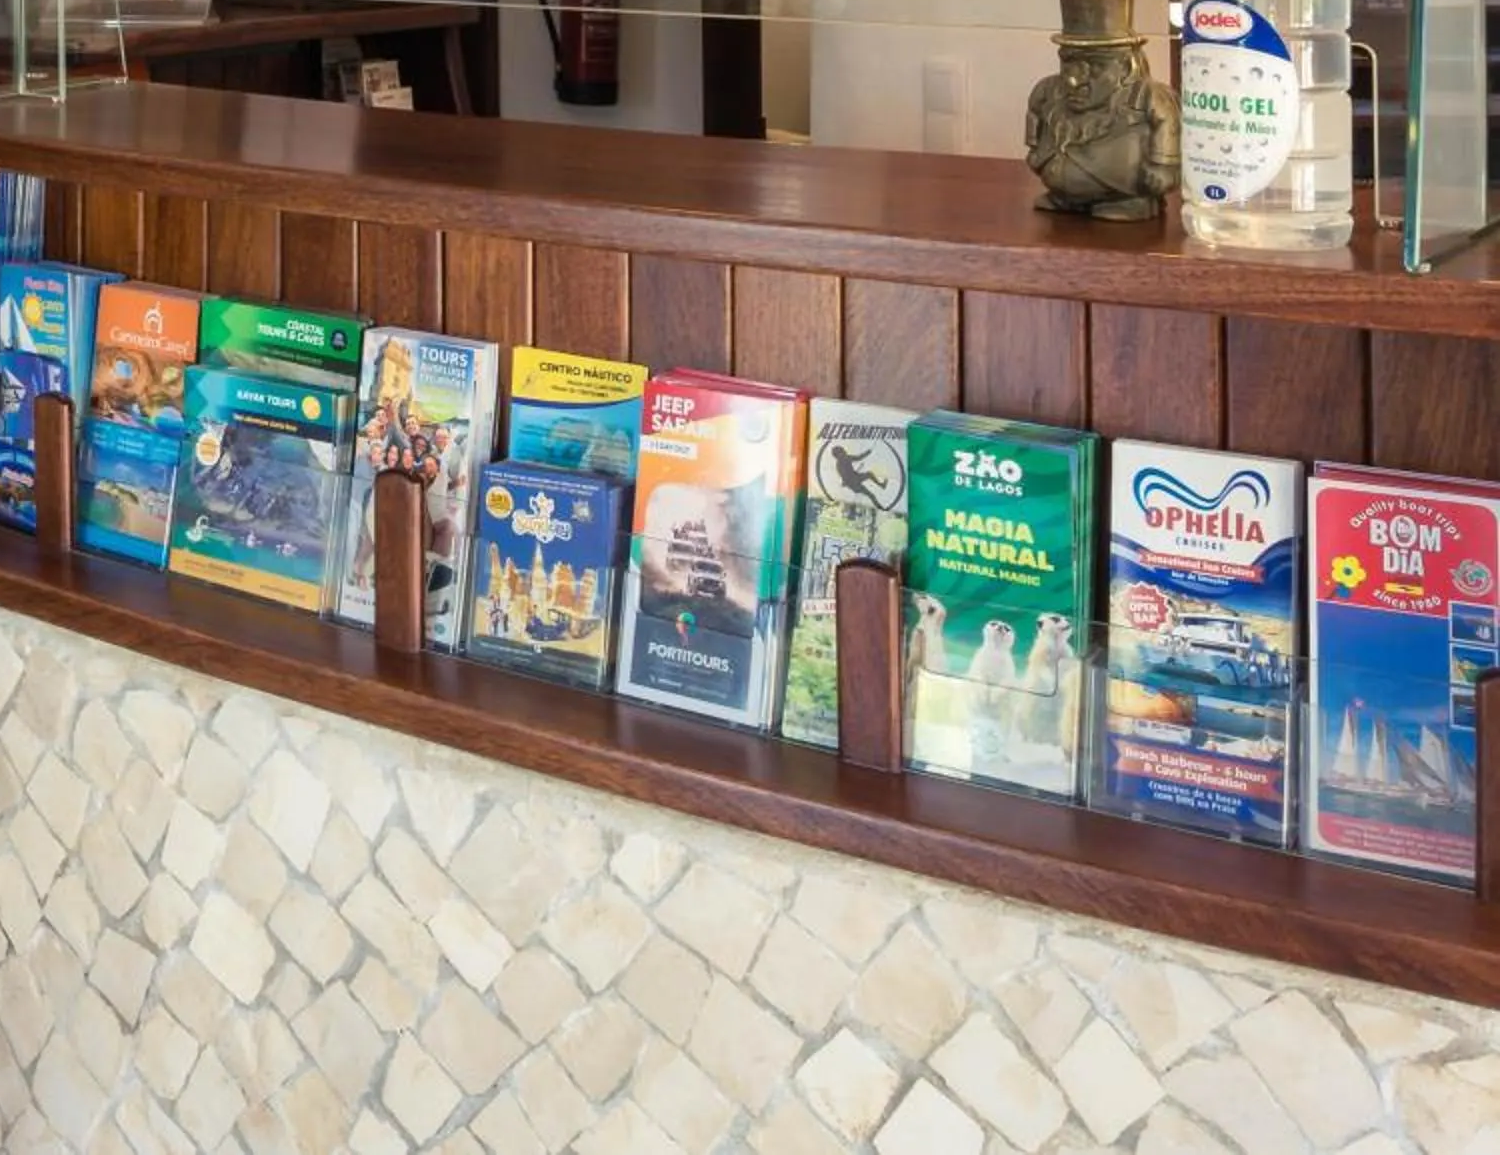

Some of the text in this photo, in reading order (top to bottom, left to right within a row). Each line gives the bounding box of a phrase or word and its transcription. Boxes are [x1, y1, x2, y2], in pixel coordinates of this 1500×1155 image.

[1240, 96, 1278, 116] GEL
[258, 323, 287, 340] TOURS
[297, 331, 325, 347] CAVES
[286, 319, 325, 337] COASTAL
[420, 346, 469, 368] TOURS
[539, 362, 633, 384] CENTRO NÁUTICO
[236, 389, 298, 411] KAYAK TOURS
[652, 394, 695, 416] JEEP
[955, 475, 1023, 497] DE LAGOS
[944, 508, 1035, 545] MAGIA
[1145, 505, 1265, 544] OPHELIA
[1399, 498, 1433, 518] boat
[1435, 511, 1462, 541] trips
[1175, 536, 1226, 552] CRUISES
[1369, 514, 1442, 553] BOM
[926, 528, 1055, 572] NATURAL
[938, 557, 1041, 587] NATURAL MAGIC
[1145, 551, 1200, 571] Sensational
[1221, 563, 1256, 579] Cruises
[1129, 601, 1160, 615] OPEN
[1372, 588, 1407, 610] since
[1133, 611, 1158, 624] BAR
[1124, 745, 1159, 763] Beach
[1160, 753, 1214, 774] Barbecue
[1235, 763, 1269, 784] hours
[1185, 769, 1248, 792] Exploration
